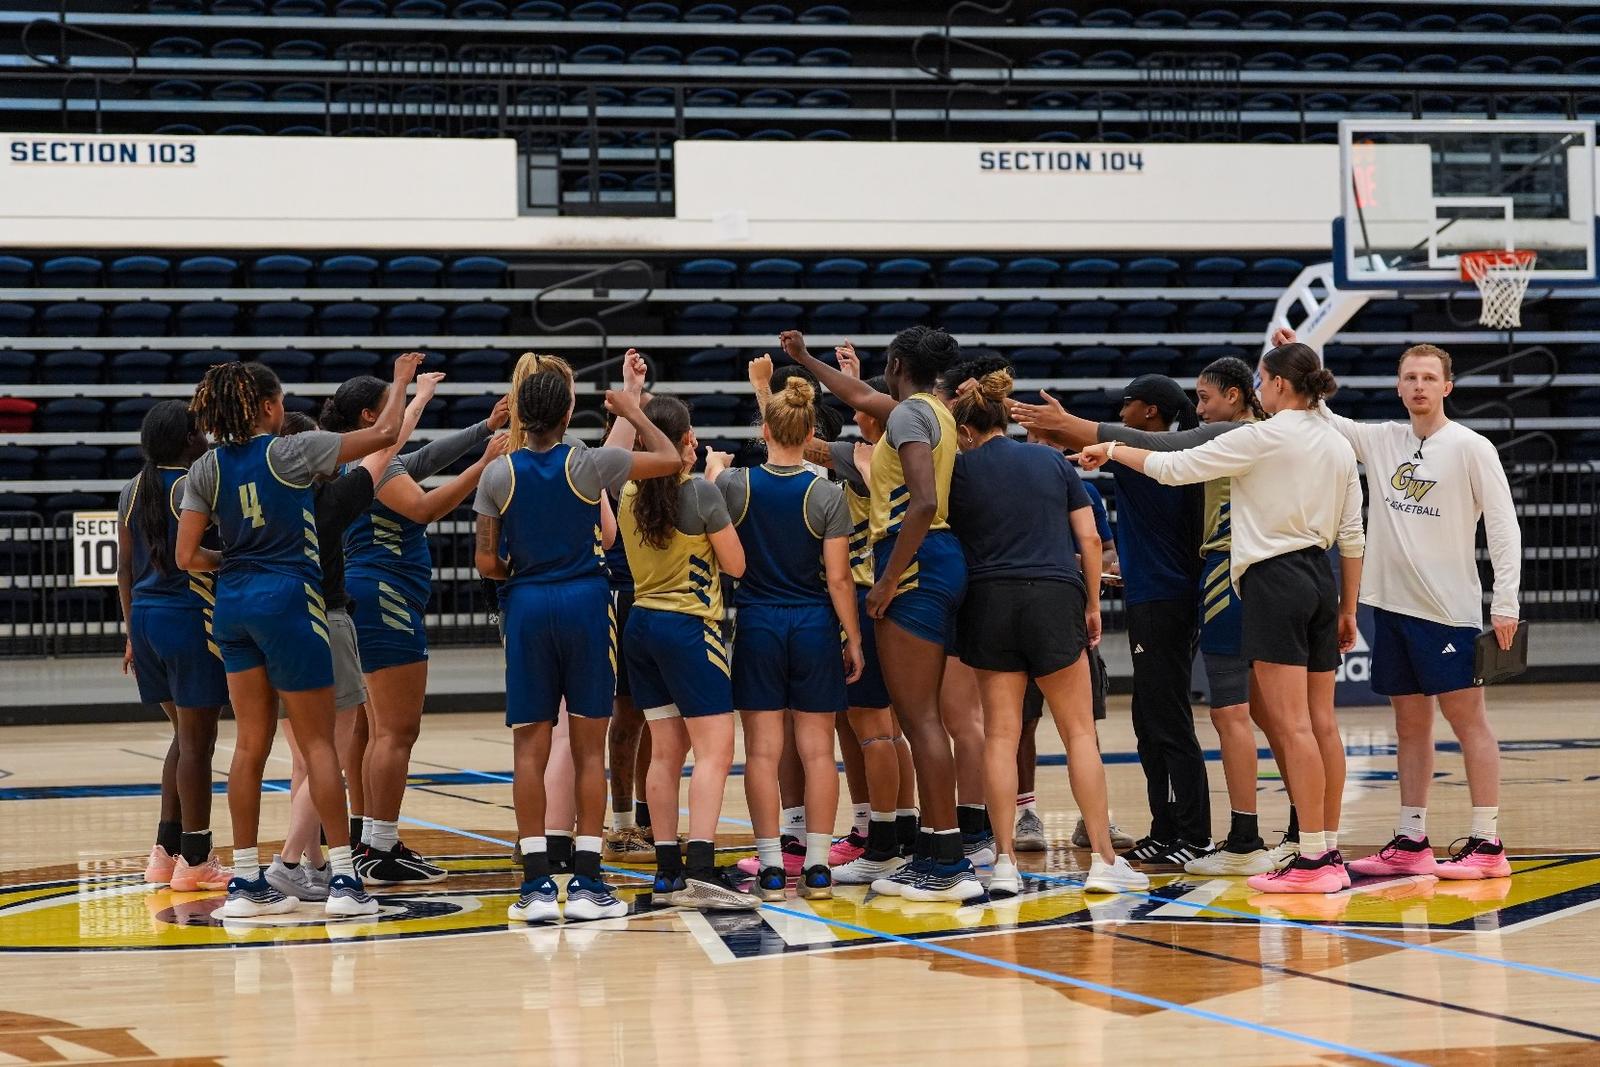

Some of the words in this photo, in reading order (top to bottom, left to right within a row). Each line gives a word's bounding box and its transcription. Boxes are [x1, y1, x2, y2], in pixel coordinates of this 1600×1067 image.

[10, 141, 138, 163] SECTION
[147, 143, 196, 164] 103
[979, 151, 1092, 171] SECTION
[1101, 151, 1145, 171] 104
[1390, 461, 1438, 502] GW
[238, 481, 266, 529] 4
[76, 520, 119, 536] SECT
[80, 540, 118, 576] 10
